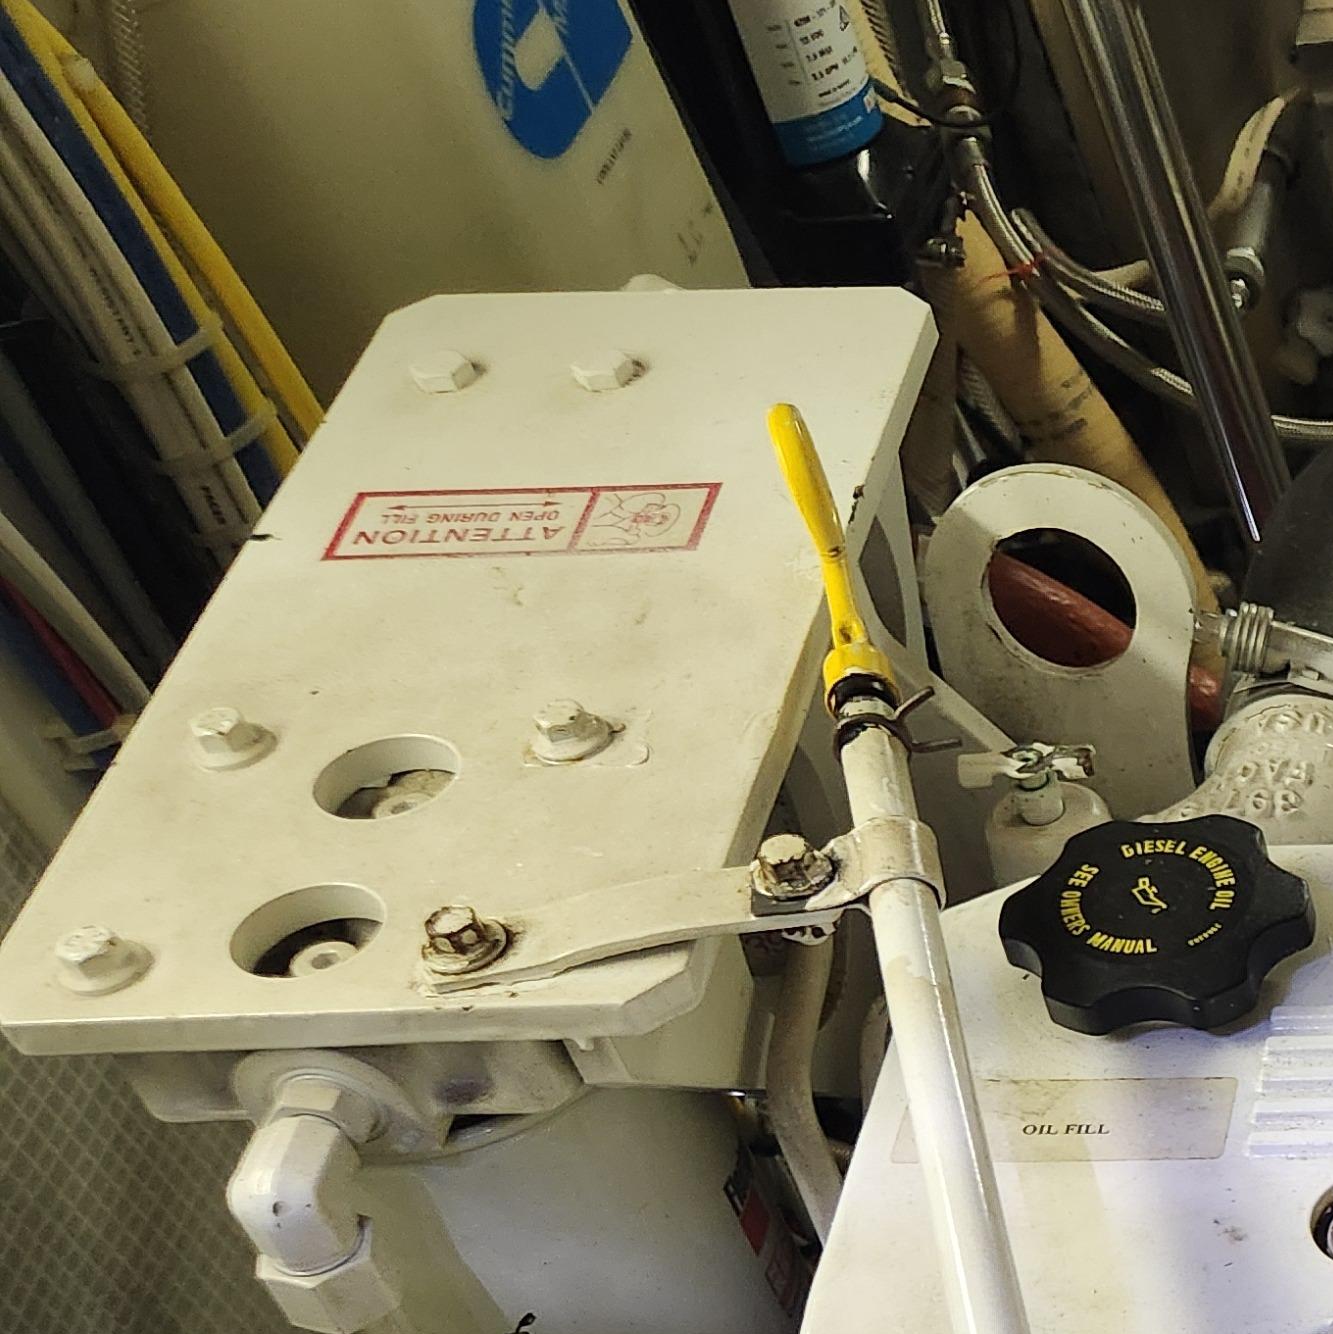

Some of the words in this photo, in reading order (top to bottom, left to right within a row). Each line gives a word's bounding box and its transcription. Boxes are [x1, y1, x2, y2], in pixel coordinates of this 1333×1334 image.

[381, 514, 419, 524] FILL
[426, 512, 501, 523] DURING
[509, 510, 560, 521] OPEN
[354, 526, 565, 545] ATTENTION
[1120, 839, 1188, 858] DIESEL
[1068, 864, 1100, 888] SEE
[1188, 846, 1236, 888] ENGINE
[1209, 890, 1236, 910] OIL
[1060, 890, 1091, 936] OWNERS
[1086, 931, 1158, 954] MANUAL
[1022, 1124, 1058, 1135] OIL
[1064, 1124, 1110, 1135] FILL
